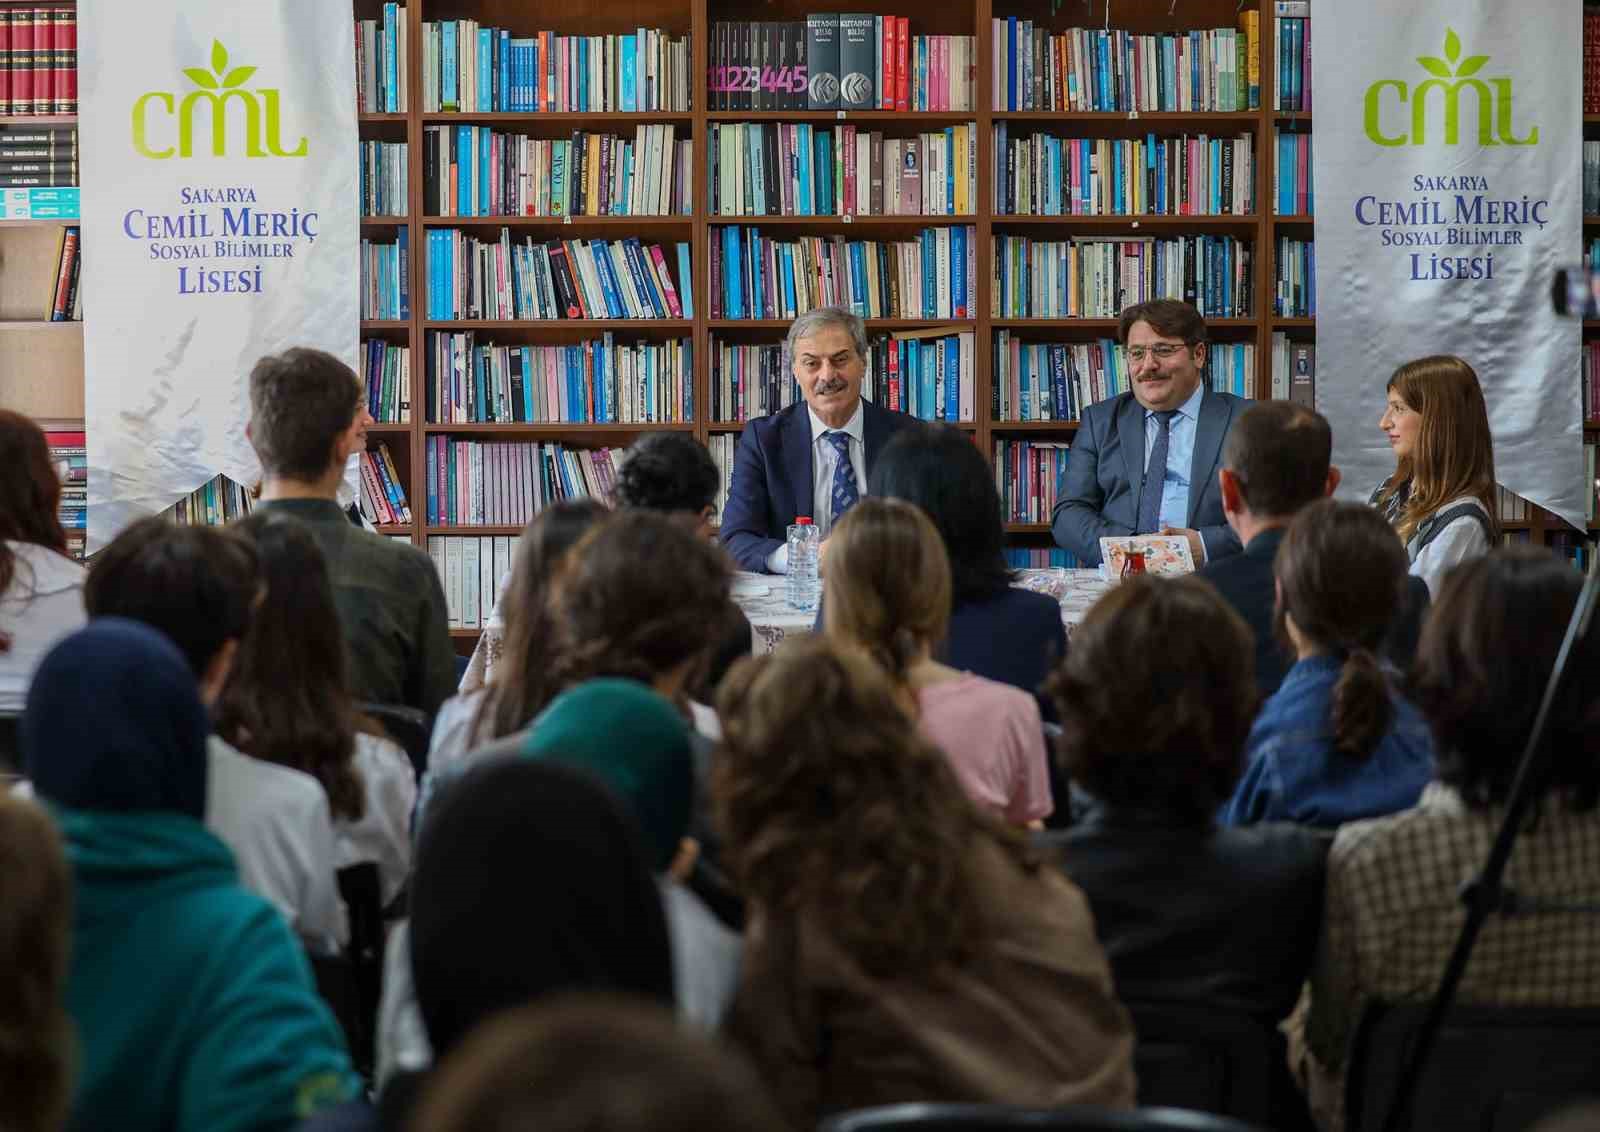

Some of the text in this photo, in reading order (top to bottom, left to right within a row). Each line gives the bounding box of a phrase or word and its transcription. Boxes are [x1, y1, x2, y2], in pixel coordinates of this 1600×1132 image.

[1414, 174, 1488, 191] SAKARYA
[181, 187, 256, 204] SAKARYA
[1355, 195, 1548, 230] CEMİL MERİÇ
[123, 207, 318, 243] CEMİL MERİÇ
[1382, 227, 1522, 246] SOSYAL BİLİMLER
[150, 240, 293, 259] SOSYAL BİLİMLER
[1410, 252, 1494, 281] LİSESİ
[178, 265, 262, 294] LİSESİ
